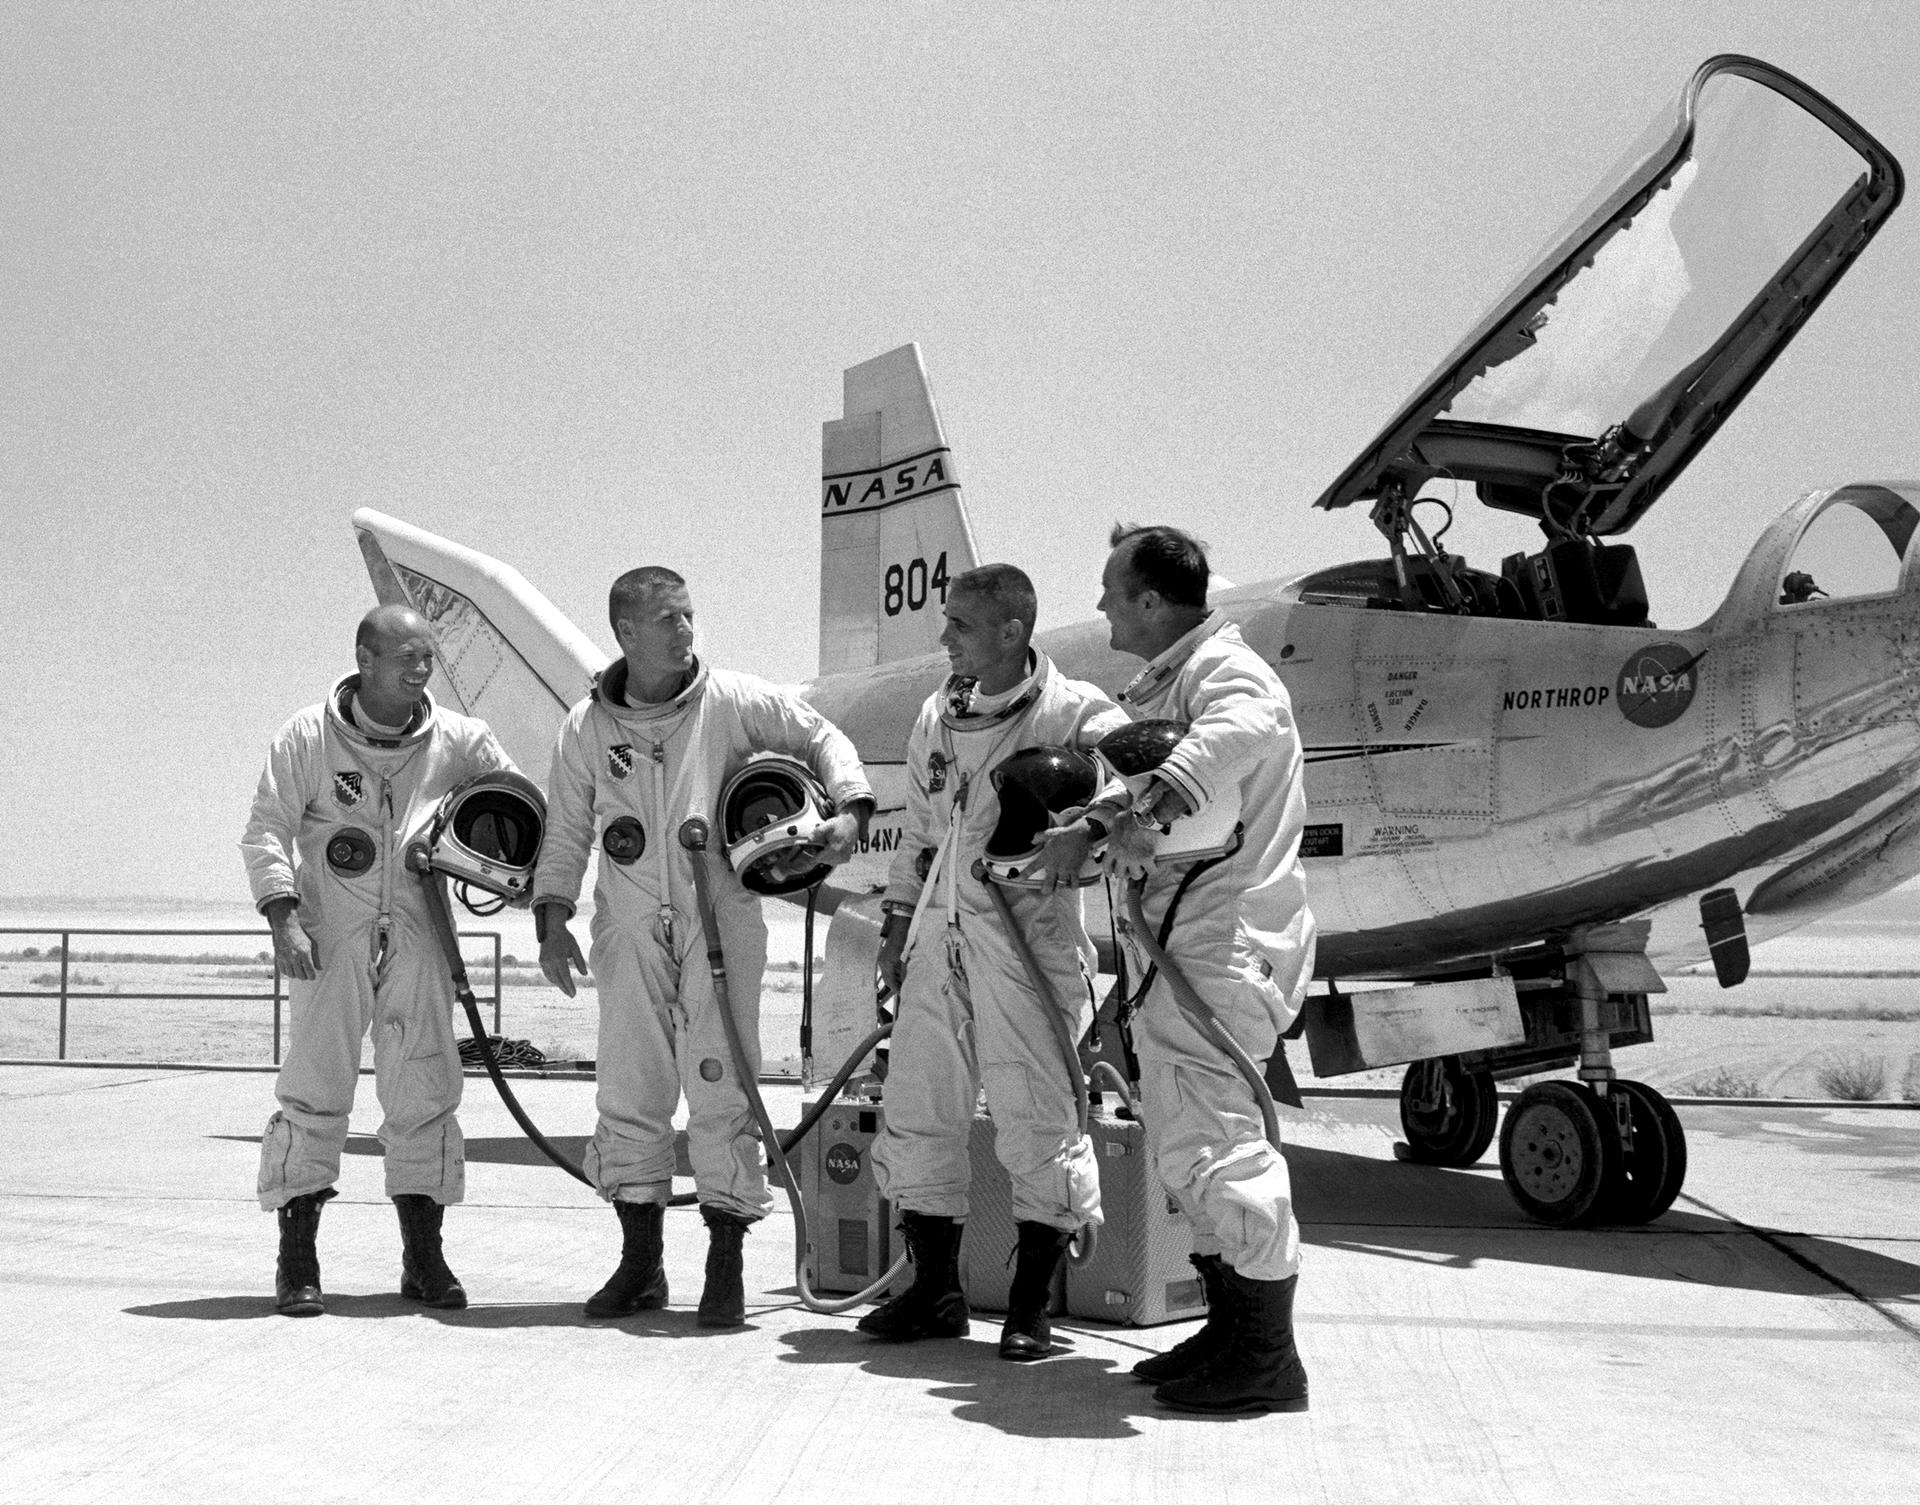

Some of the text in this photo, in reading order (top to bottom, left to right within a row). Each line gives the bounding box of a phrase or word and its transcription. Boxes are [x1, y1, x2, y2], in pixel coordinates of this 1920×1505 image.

[824, 458, 945, 508] NASA
[884, 551, 951, 617] 804
[1622, 673, 1692, 695] NASA
[1503, 686, 1610, 710] NORTHROP
[1367, 702, 1383, 733] DANGER
[1404, 699, 1428, 731] DANGER
[1374, 824, 1419, 837] WARNING
[828, 1158, 859, 1170] NASA
